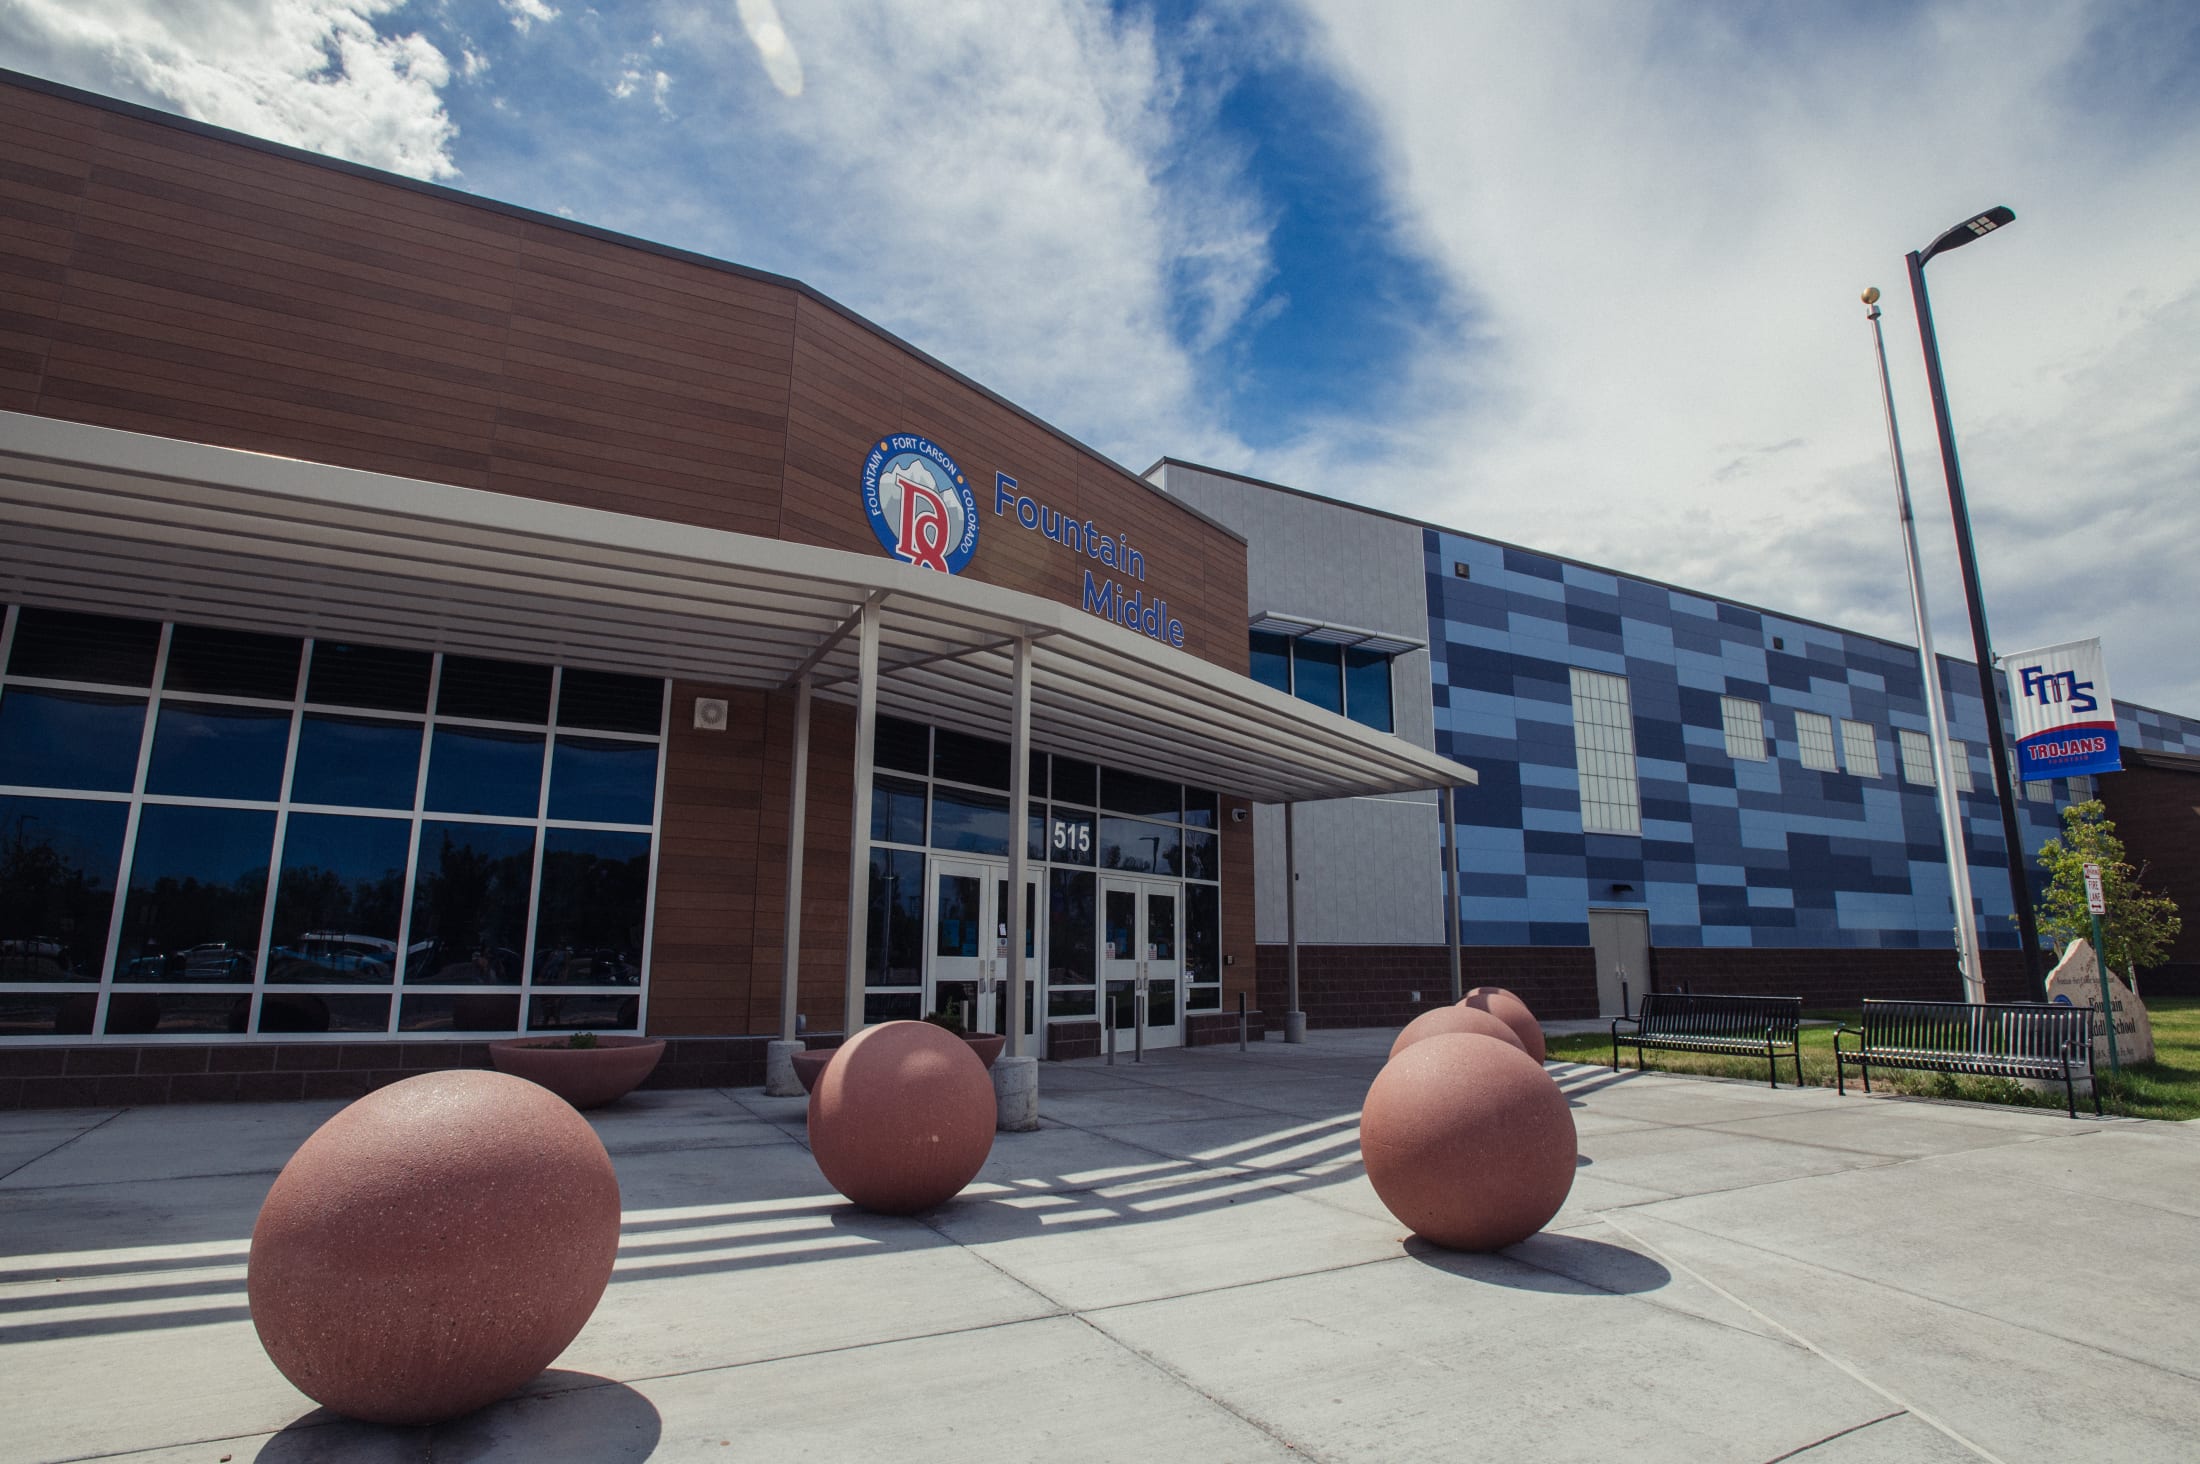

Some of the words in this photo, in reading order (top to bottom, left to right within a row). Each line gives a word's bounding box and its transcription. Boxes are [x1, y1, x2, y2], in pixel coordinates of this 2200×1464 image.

[892, 437, 917, 449] FORT
[919, 441, 957, 475] CARSON
[863, 450, 883, 516] FOUNTAIN
[960, 489, 976, 554] COLORADO
[994, 471, 1145, 581] Fountain
[1083, 569, 1185, 648] Middle
[2027, 736, 2107, 760] TROJANS
[1054, 821, 1090, 852] 515
[2088, 880, 2099, 891] FIRE
